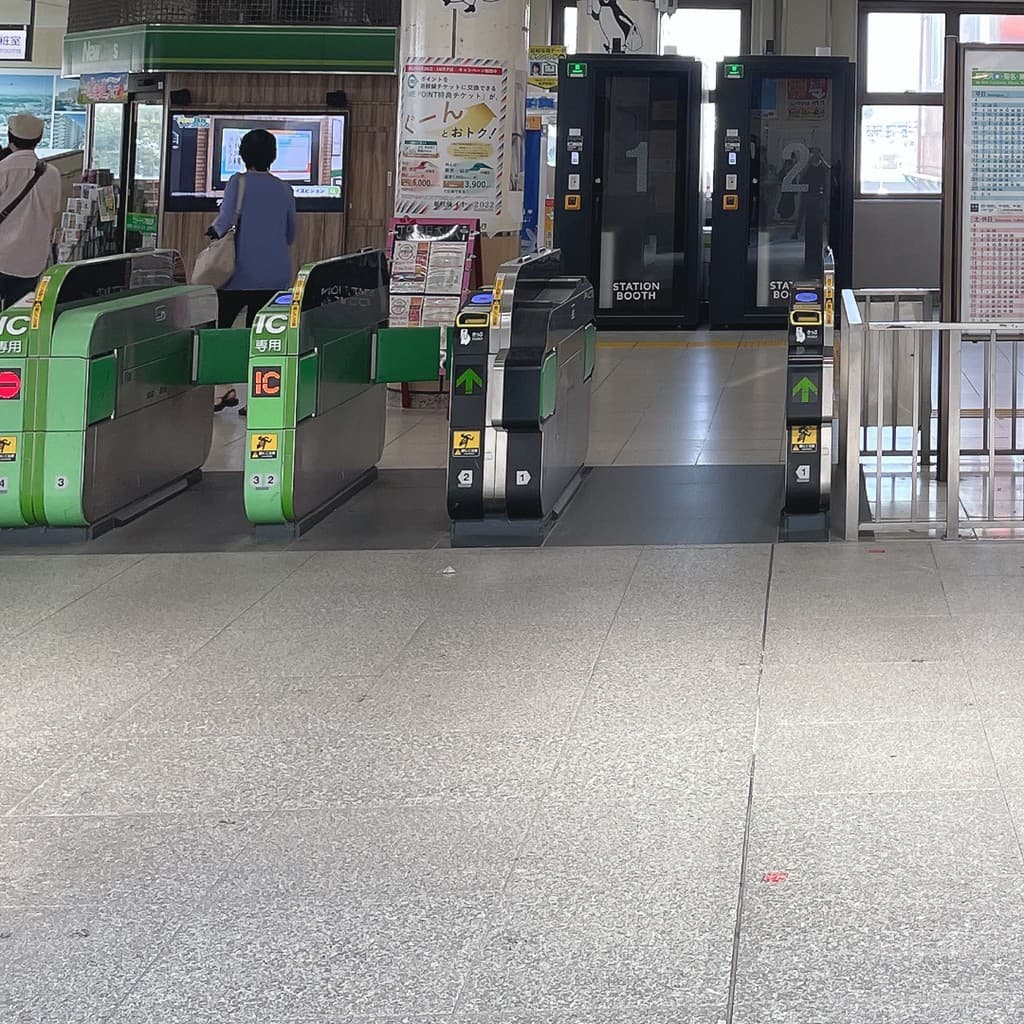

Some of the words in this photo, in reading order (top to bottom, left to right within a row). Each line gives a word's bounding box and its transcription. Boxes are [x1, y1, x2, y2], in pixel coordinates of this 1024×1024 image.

[626, 142, 648, 192] 1
[781, 142, 810, 193] 2
[612, 282, 660, 292] STATION
[616, 291, 656, 301] BOOTH
[255, 314, 288, 334] IC
[255, 339, 281, 352] 専用
[255, 371, 280, 395] IC
[253, 476, 260, 485] 3
[268, 476, 275, 485] 2
[463, 472, 470, 481] 2
[57, 478, 65, 487] 3
